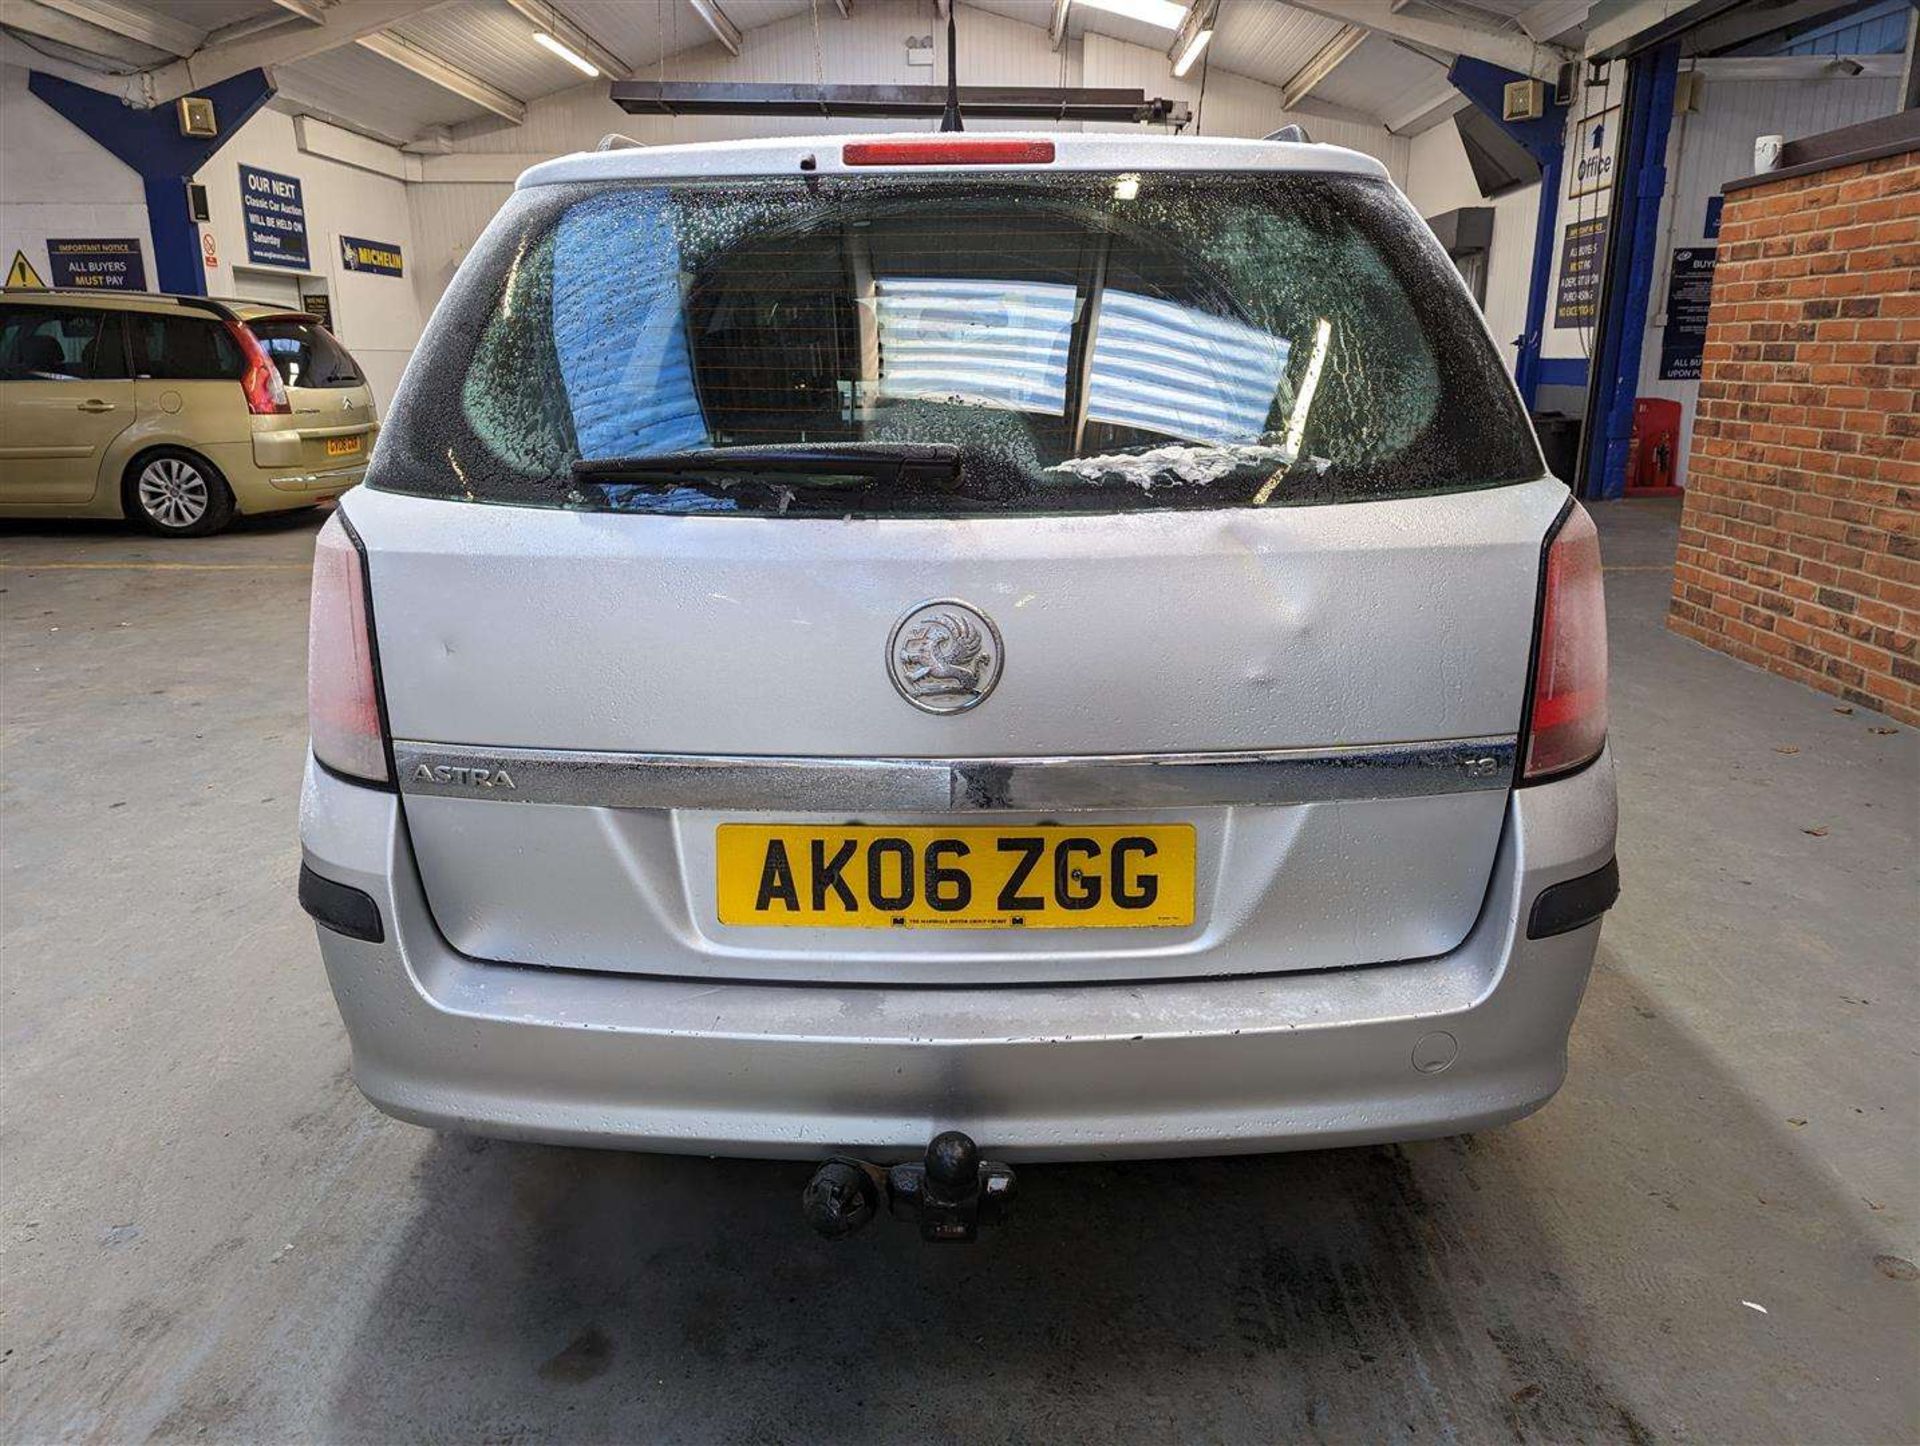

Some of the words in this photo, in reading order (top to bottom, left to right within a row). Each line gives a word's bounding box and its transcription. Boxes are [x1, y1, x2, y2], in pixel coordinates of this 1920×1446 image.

[1577, 155, 1612, 181] Office
[248, 174, 271, 193] OUR
[271, 180, 296, 199] NEXT
[244, 194, 268, 209] Classic
[268, 200, 280, 212] Car
[280, 203, 303, 216] Auction
[248, 213, 266, 226] WILL
[266, 216, 276, 228] BE
[276, 219, 293, 232] HELD
[293, 222, 304, 233] ON
[58, 244, 100, 253] IMPORTANT
[101, 244, 129, 252] NOTICE
[252, 231, 281, 248] Saturday
[68, 262, 87, 272] ALL
[88, 261, 127, 272] BUYERS
[358, 247, 402, 269] MICHELIN
[75, 276, 104, 286] MUST
[105, 276, 124, 286] PAY
[1673, 358, 1689, 367] ALL
[412, 764, 516, 789] ASTRA
[755, 838, 972, 912] AK06
[996, 837, 1160, 911] ZGG
